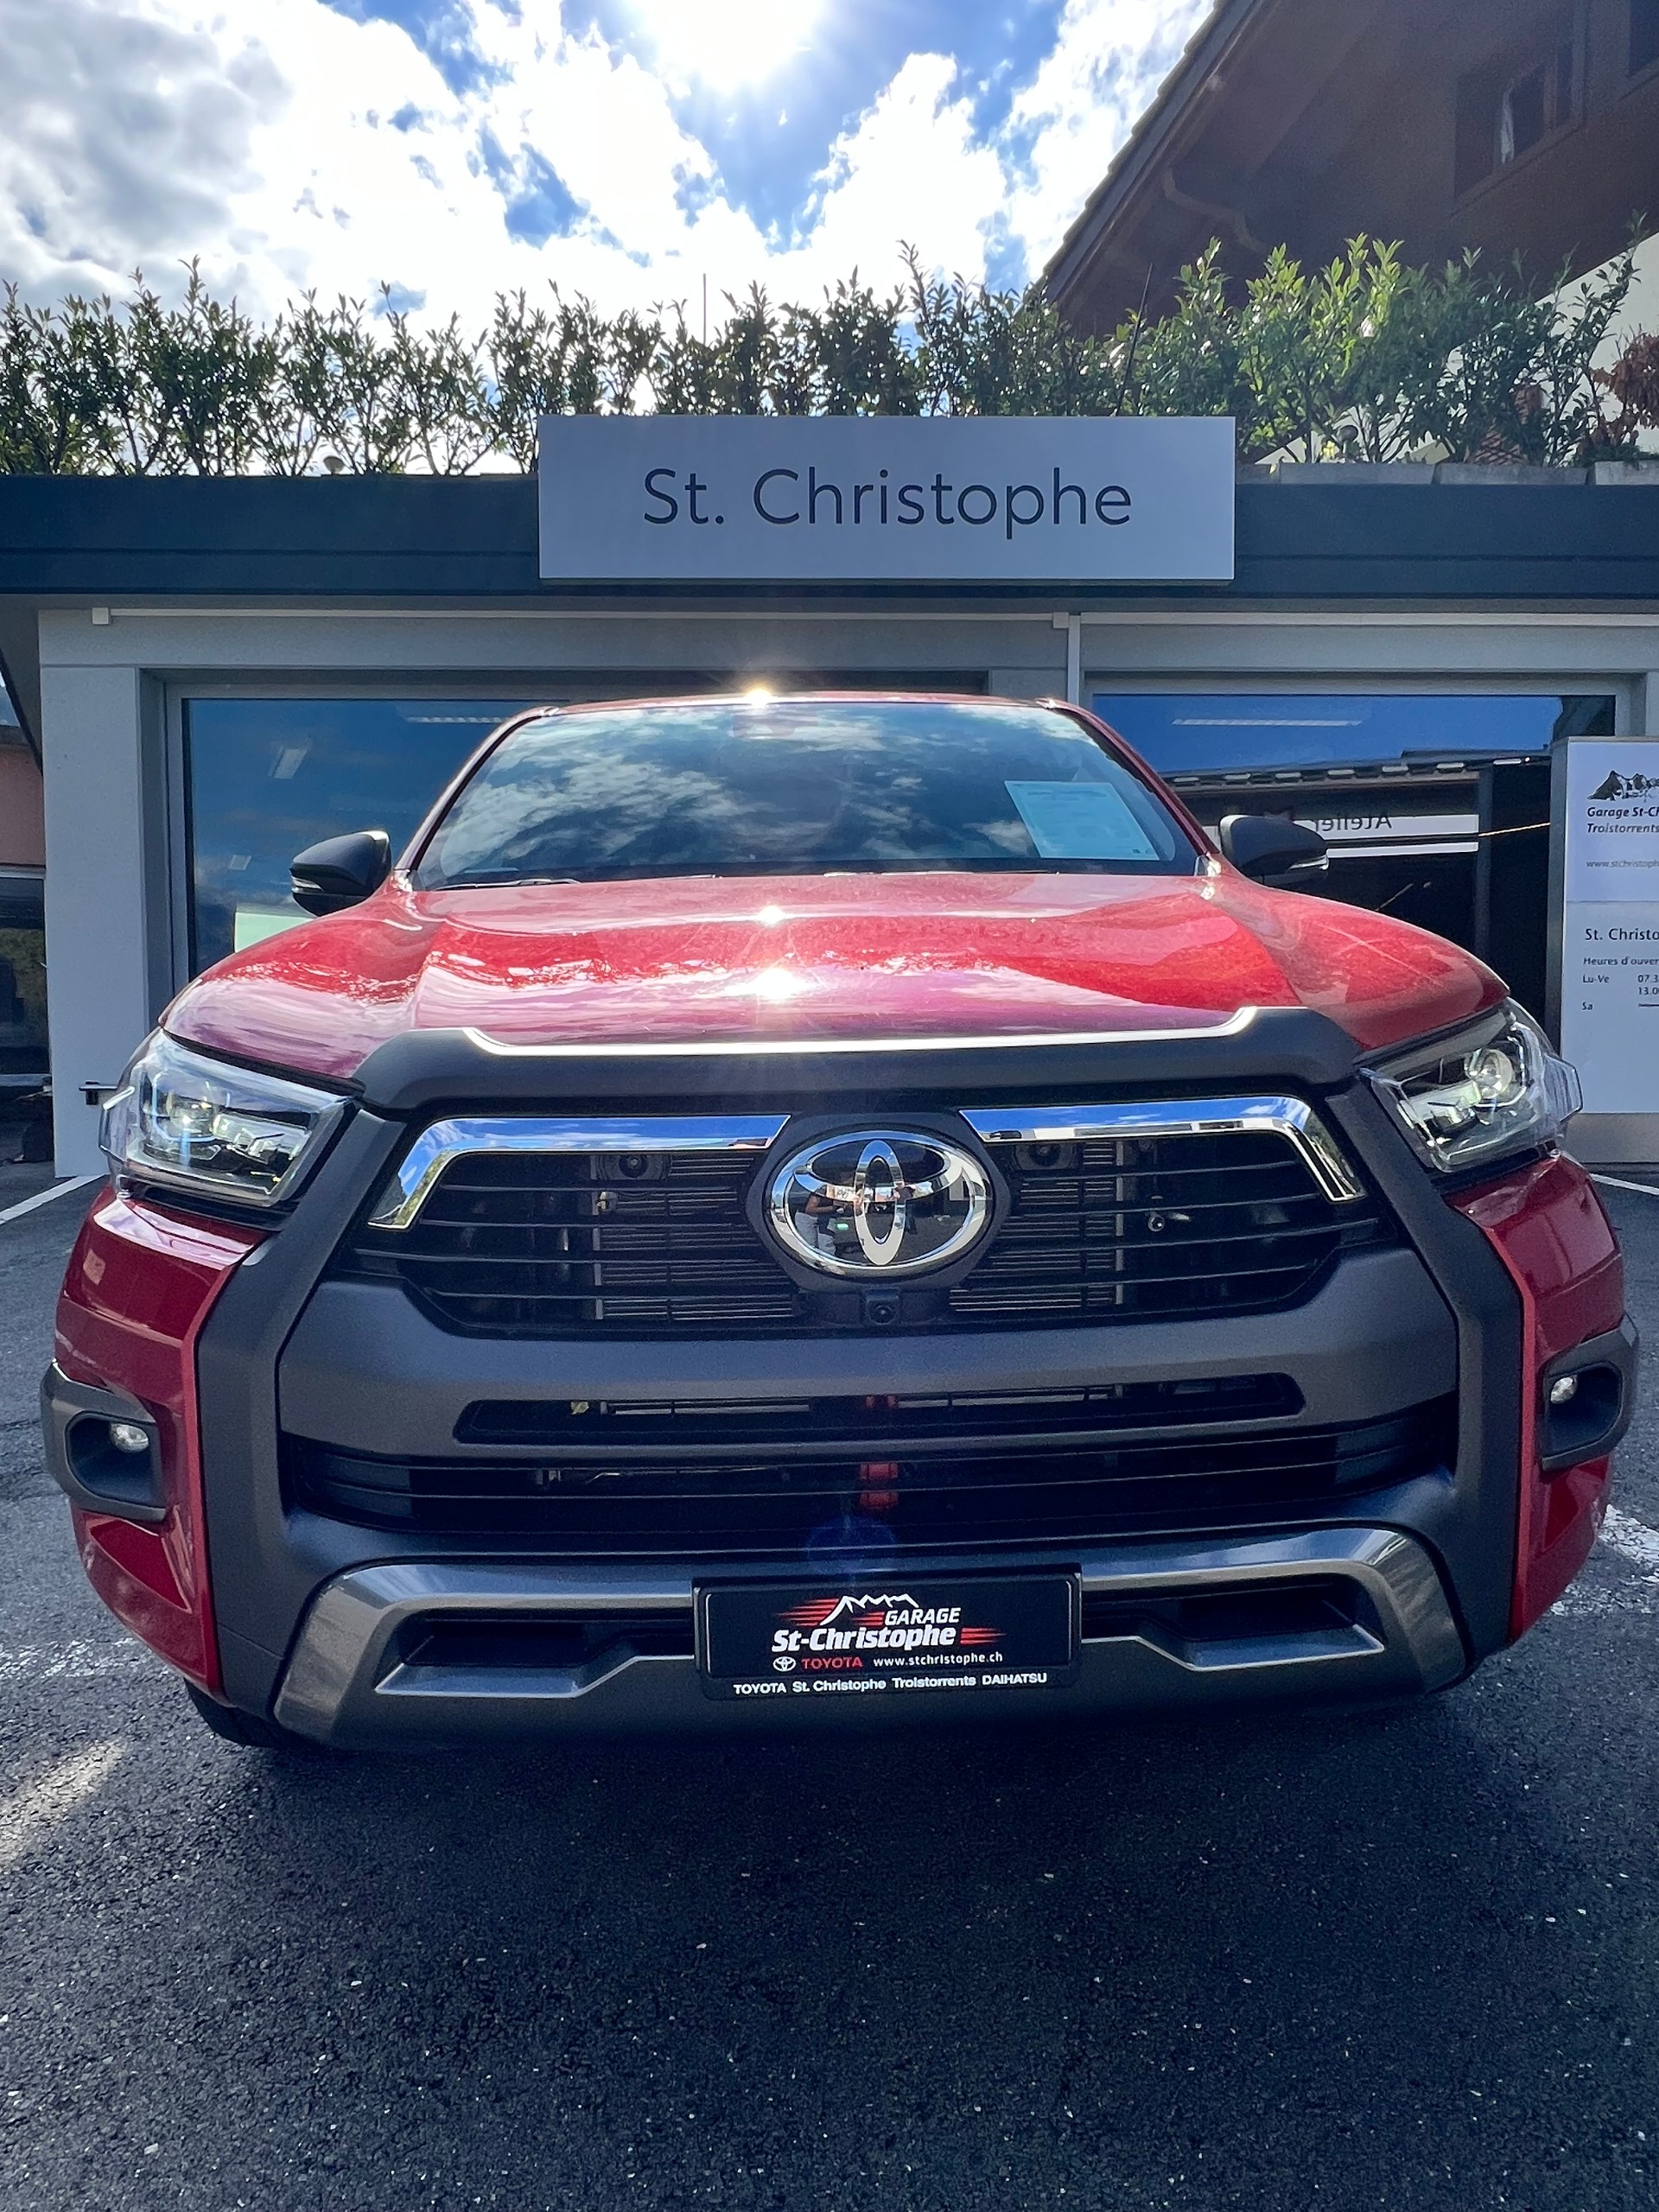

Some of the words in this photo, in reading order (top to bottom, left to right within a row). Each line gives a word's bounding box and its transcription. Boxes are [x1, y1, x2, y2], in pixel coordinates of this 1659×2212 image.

[644, 467, 725, 525] St.
[753, 466, 1132, 540] Christophe
[1586, 806, 1630, 820] Garage
[1585, 928, 1604, 941] St.
[1608, 927, 1659, 941] Christo
[1583, 957, 1618, 965] Heures
[1582, 975, 1610, 983] Lu-Ve
[1581, 1001, 1593, 1011] Sa
[884, 1607, 962, 1627] GARAGE
[771, 1624, 957, 1653] St-Christophe
[801, 1656, 863, 1670] TOYOTA
[873, 1651, 1004, 1668] www.stchristophe.ch
[733, 1681, 787, 1695] TOYOTA
[791, 1681, 811, 1693] St.
[812, 1678, 887, 1693] Christophe
[891, 1675, 977, 1689] Troistorrents
[981, 1672, 1048, 1686] DAIHATSU
